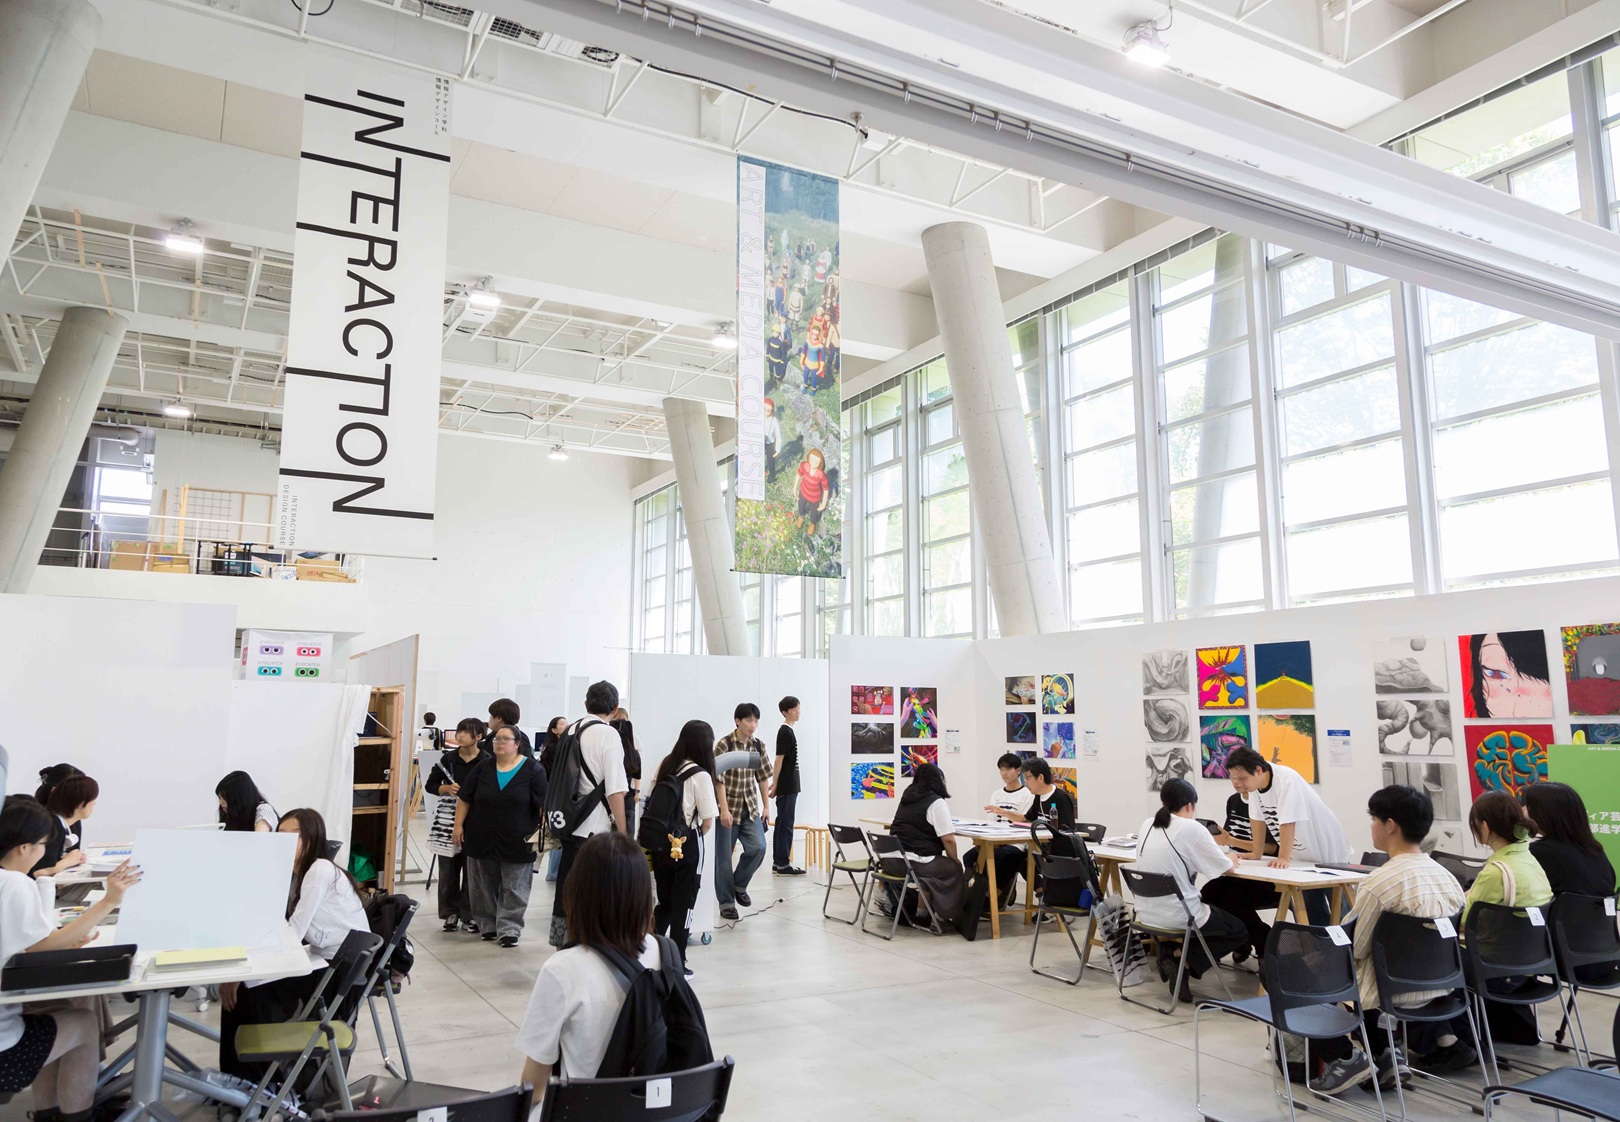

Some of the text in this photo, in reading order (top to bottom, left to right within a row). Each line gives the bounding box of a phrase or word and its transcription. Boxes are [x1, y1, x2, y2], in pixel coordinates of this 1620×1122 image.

[433, 77, 442, 136] 情報デザインコース
[441, 79, 450, 132] 情報デザイン学科
[279, 89, 451, 520] INTERACTION
[739, 163, 764, 497] ART & MEDIA COURSE
[279, 484, 290, 545] DESIGN COURSE
[288, 495, 298, 546] INTERACTION
